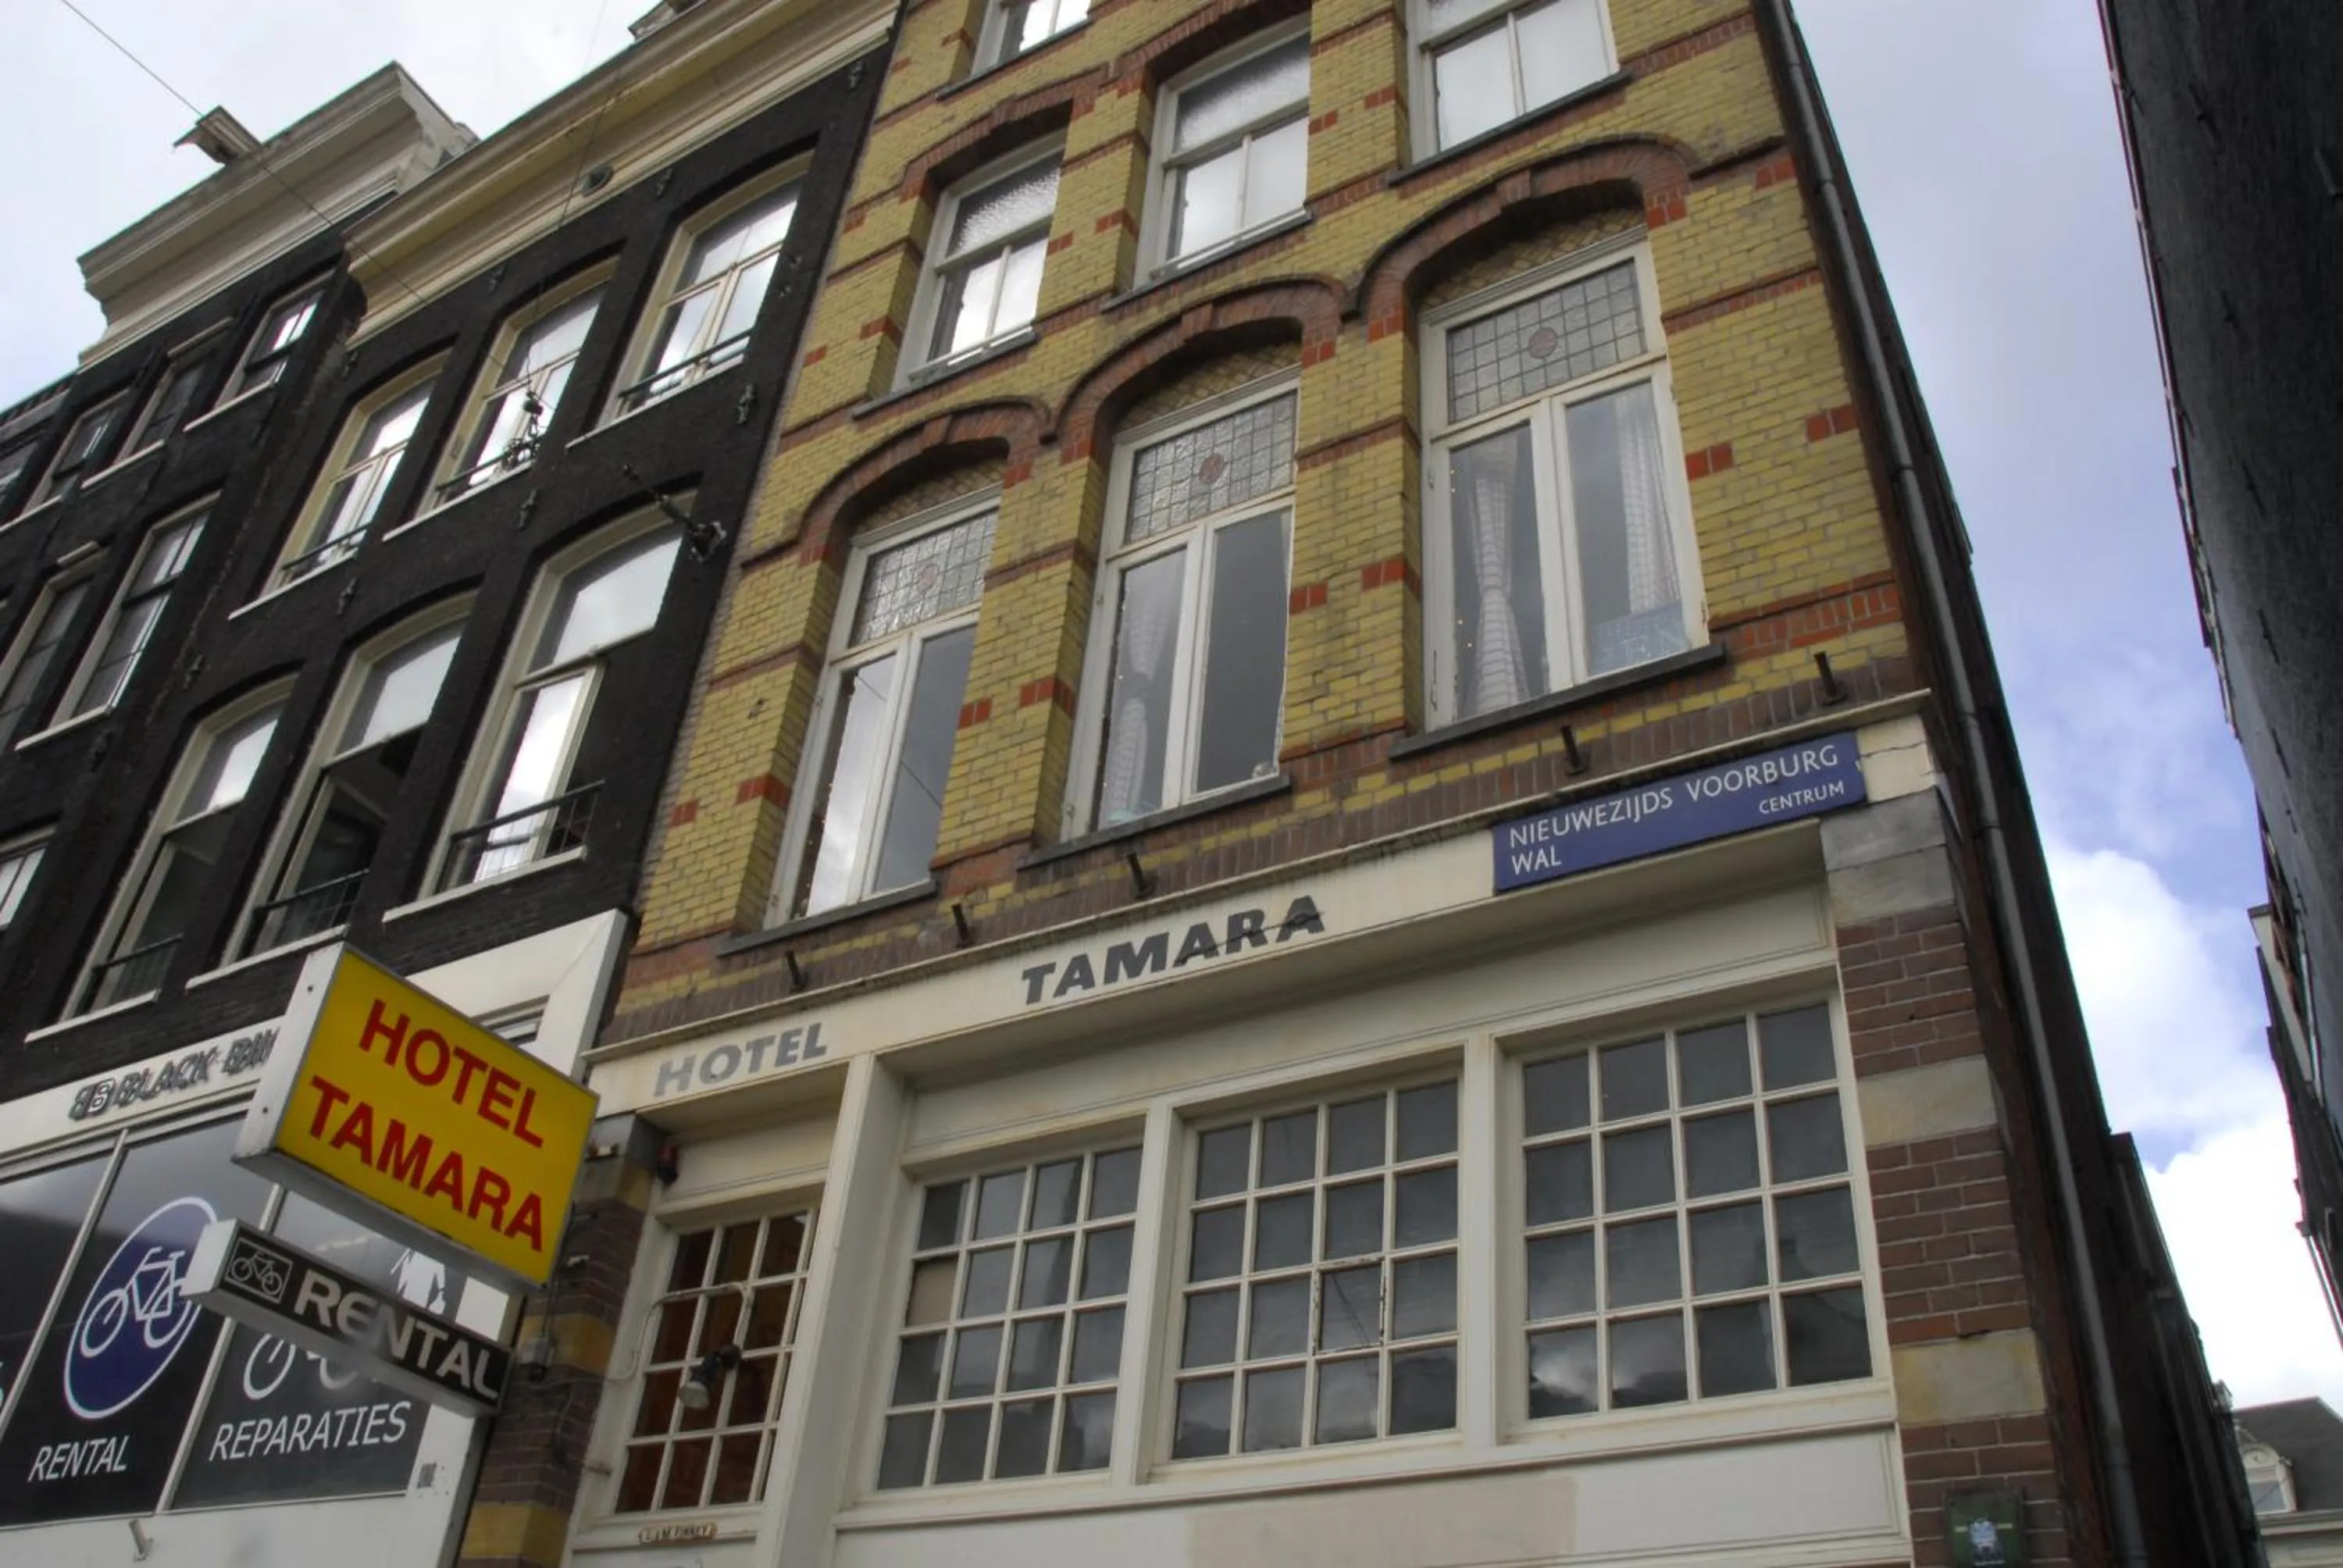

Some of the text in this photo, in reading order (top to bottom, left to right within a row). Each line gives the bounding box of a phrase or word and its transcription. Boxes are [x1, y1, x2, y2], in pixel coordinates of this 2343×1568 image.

[1510, 744, 1838, 848] NIEUWEZIJDS VOORBURG
[1759, 781, 1845, 815] CENTRUM
[1511, 846, 1562, 875] WAL
[653, 895, 1326, 1098] HOTEL TAMARA
[114, 1045, 220, 1107] BLACK
[358, 998, 544, 1149] HOTEL
[309, 1078, 544, 1253] TAMARA
[293, 1269, 498, 1400] RENTAL
[27, 1435, 130, 1482] RENTAL
[209, 1400, 411, 1463] REPARATIES
